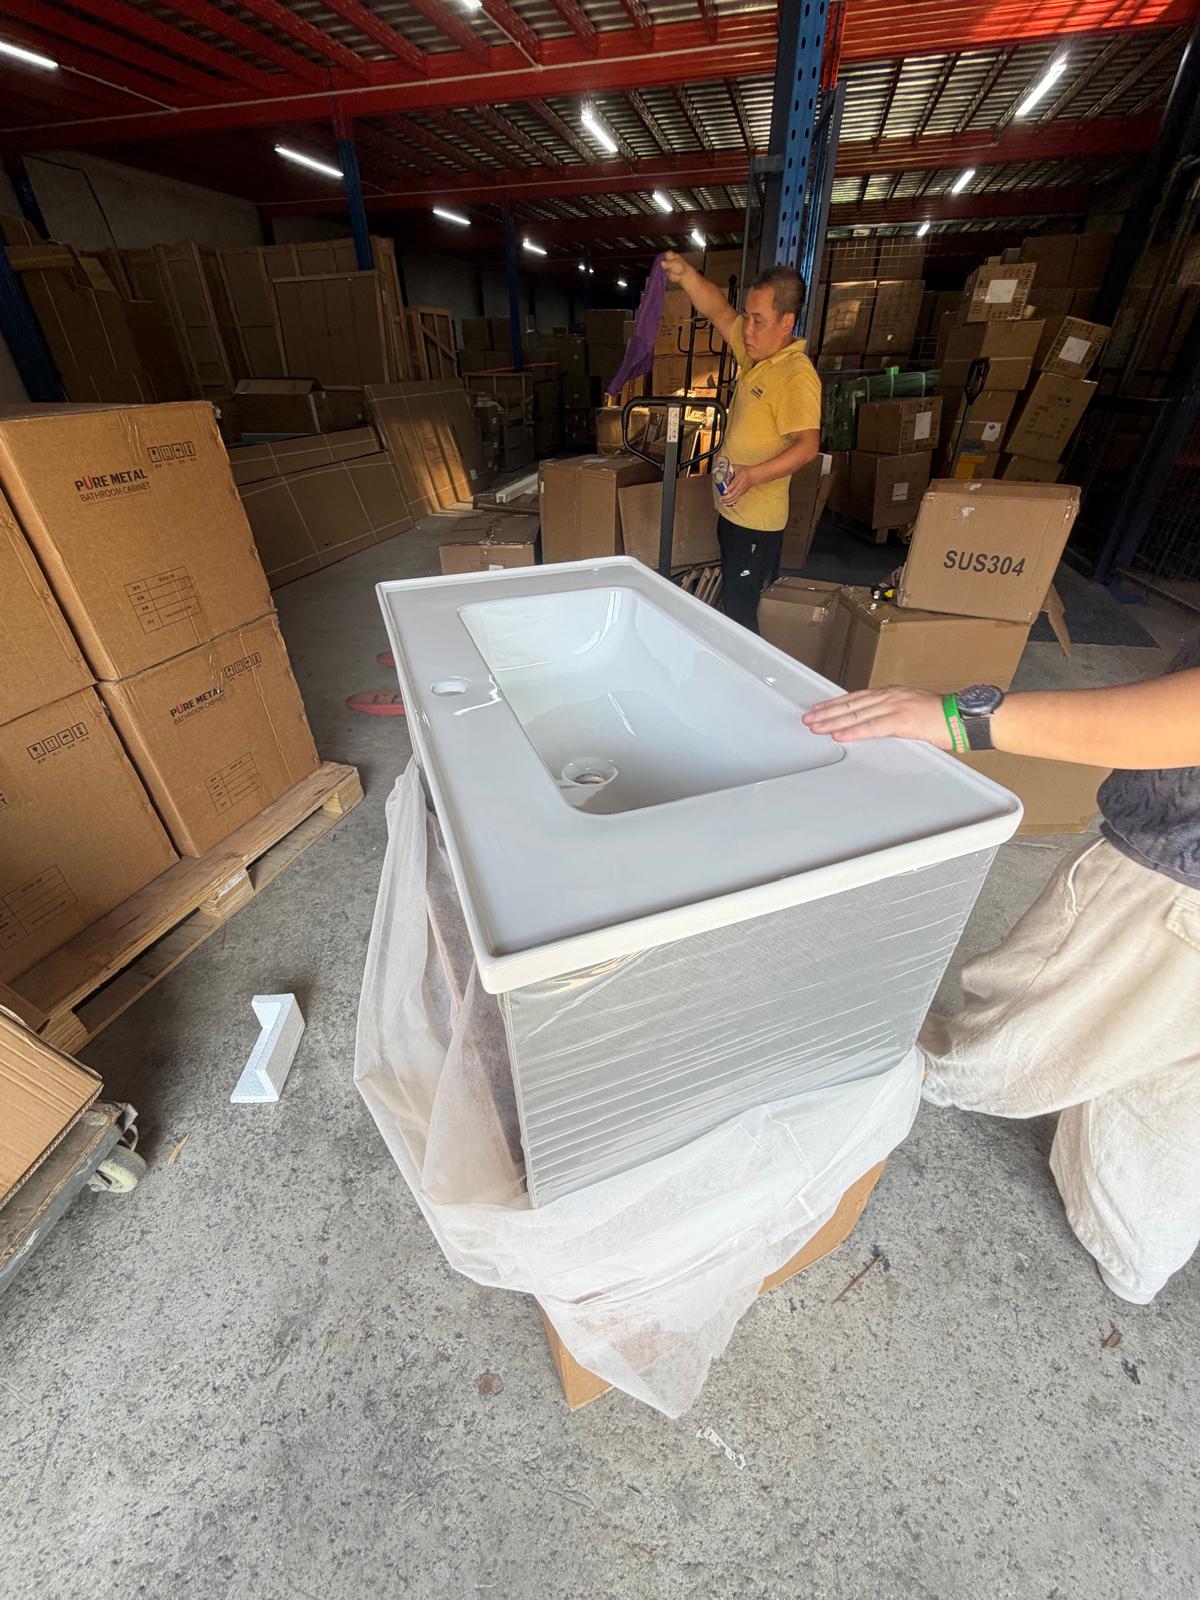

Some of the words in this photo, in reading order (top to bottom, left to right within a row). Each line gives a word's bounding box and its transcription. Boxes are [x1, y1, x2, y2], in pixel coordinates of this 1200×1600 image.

[75, 475, 110, 491] PURE
[110, 469, 148, 485] METAL
[80, 488, 121, 502] BATHROOM
[122, 482, 151, 494] CABINET
[944, 550, 1025, 576] SUS304
[170, 700, 195, 718] PURE
[195, 687, 224, 705] METAL
